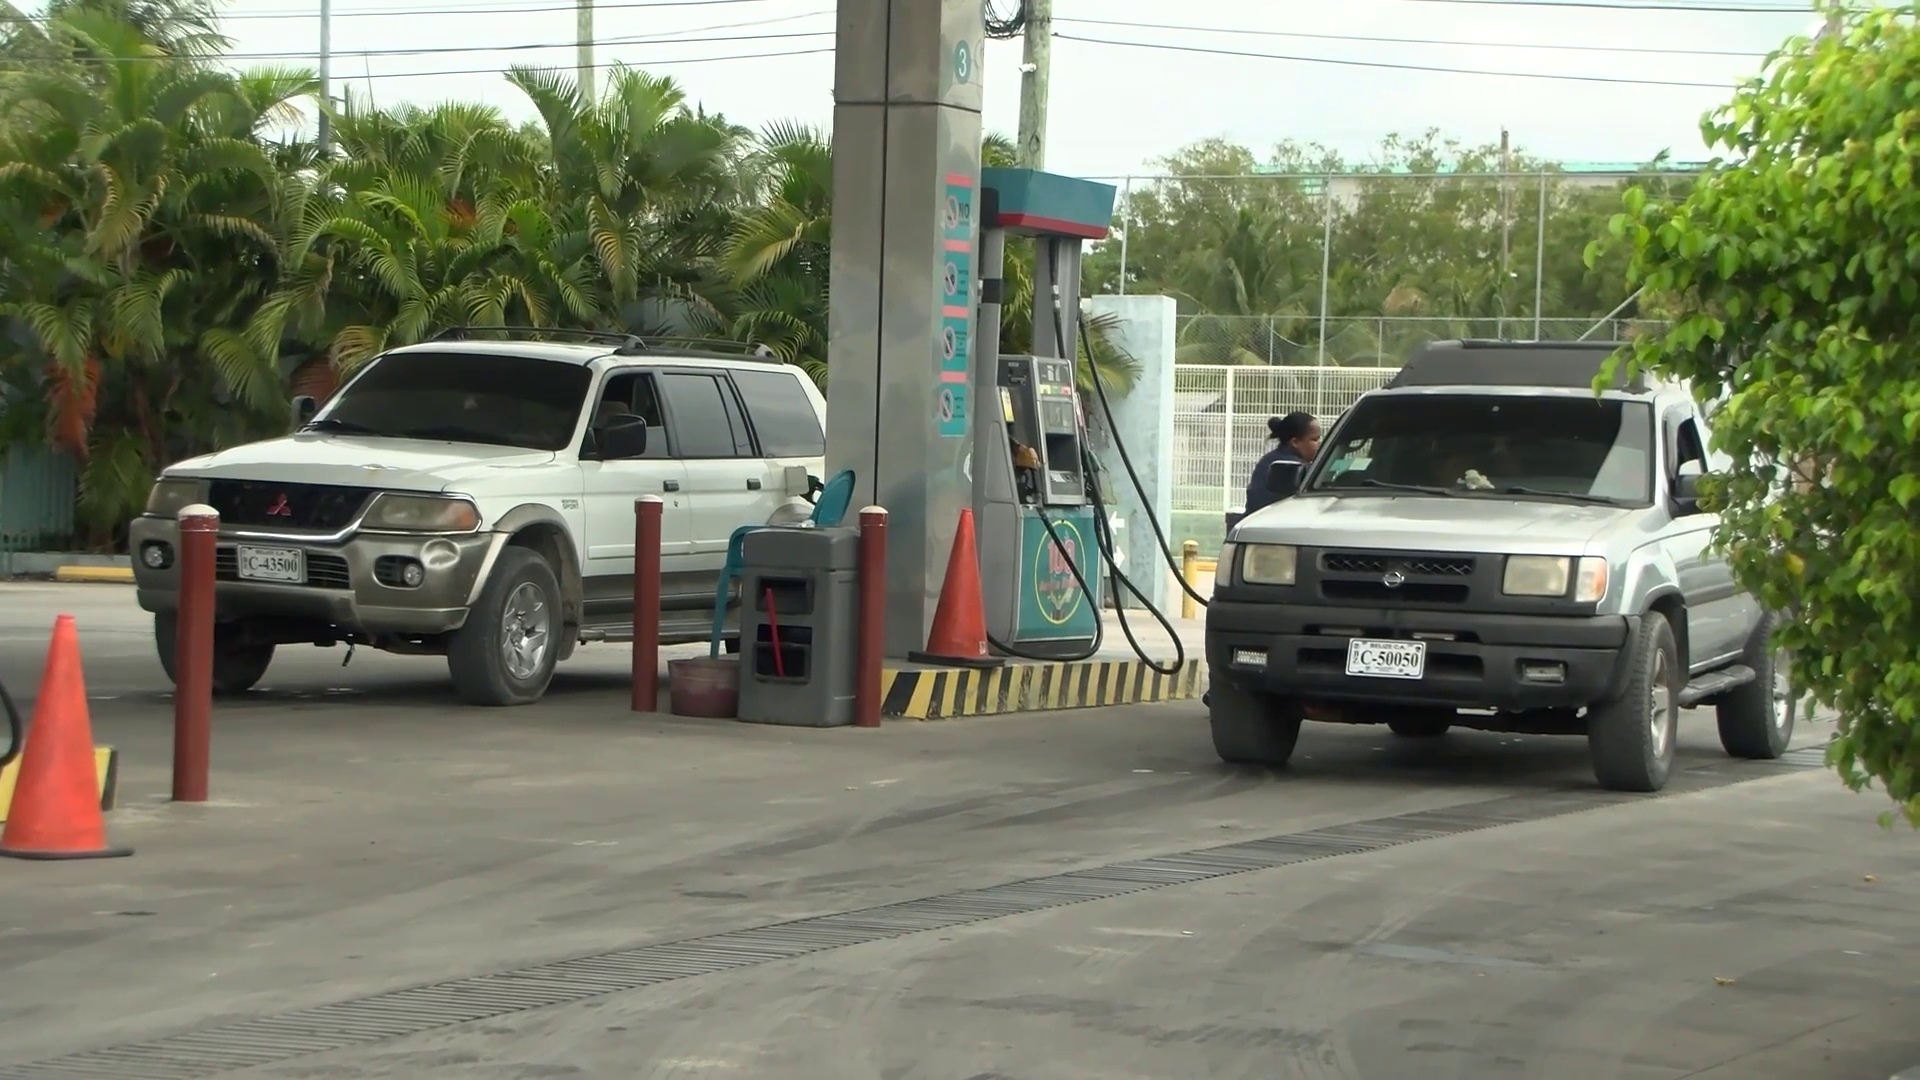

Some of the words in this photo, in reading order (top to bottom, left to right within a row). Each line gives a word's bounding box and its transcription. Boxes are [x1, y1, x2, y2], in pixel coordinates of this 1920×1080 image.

[959, 48, 967, 77] 3
[958, 203, 970, 219] NO
[248, 556, 298, 573] C-43500
[1360, 649, 1419, 668] C-50050
